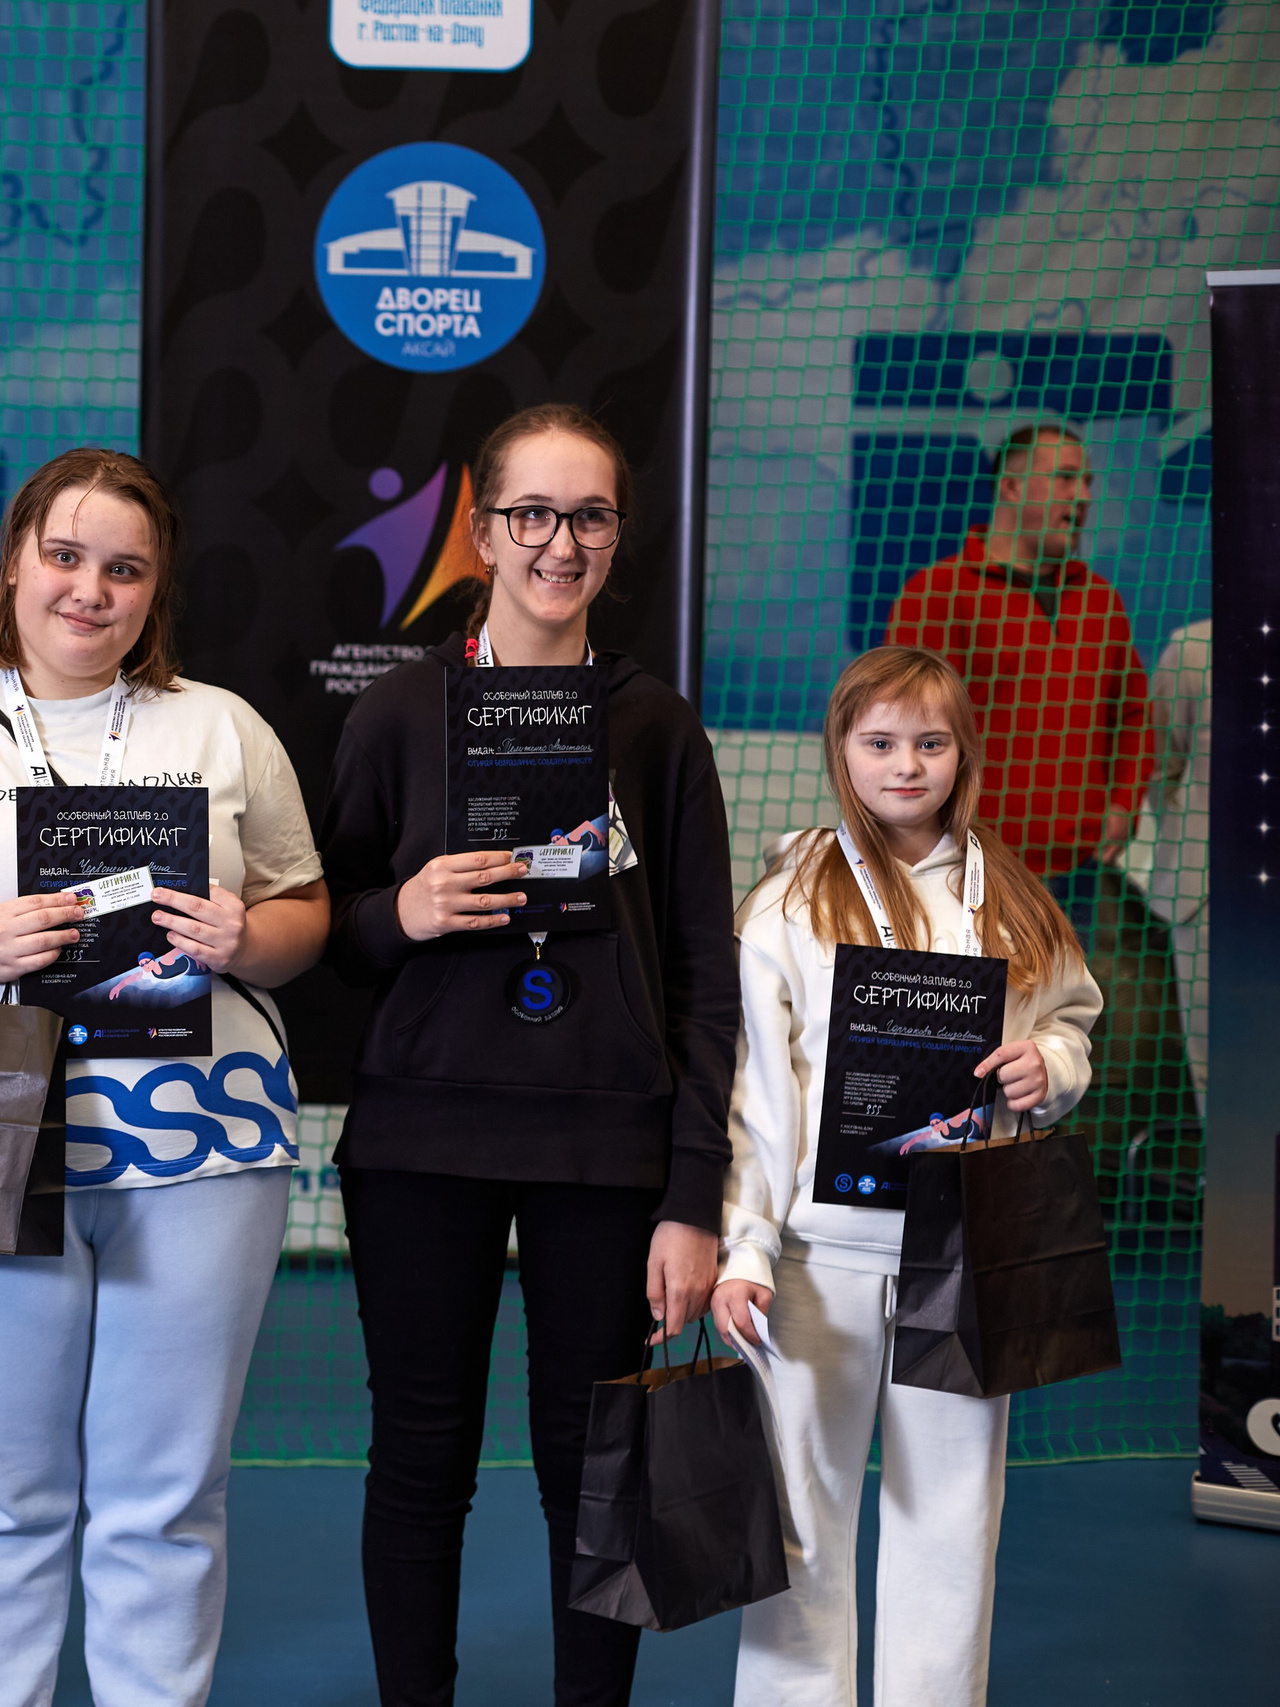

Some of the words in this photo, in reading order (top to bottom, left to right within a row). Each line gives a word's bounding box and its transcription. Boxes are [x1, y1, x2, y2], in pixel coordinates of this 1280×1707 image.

[375, 286, 482, 312] ДВОРЕЦ
[374, 312, 482, 338] СПОРТА
[401, 339, 456, 357] АКСАЙ
[332, 644, 425, 661] АГЕНТСТВО
[566, 692, 578, 700] 2.0
[467, 705, 592, 726] СЕРТИФИКАТ
[154, 812, 169, 821] 2.0
[40, 827, 187, 847] СЕРТИФИКАТ
[958, 980, 972, 988] 2.0
[854, 984, 986, 1014] СЕРТИФИКАТ
